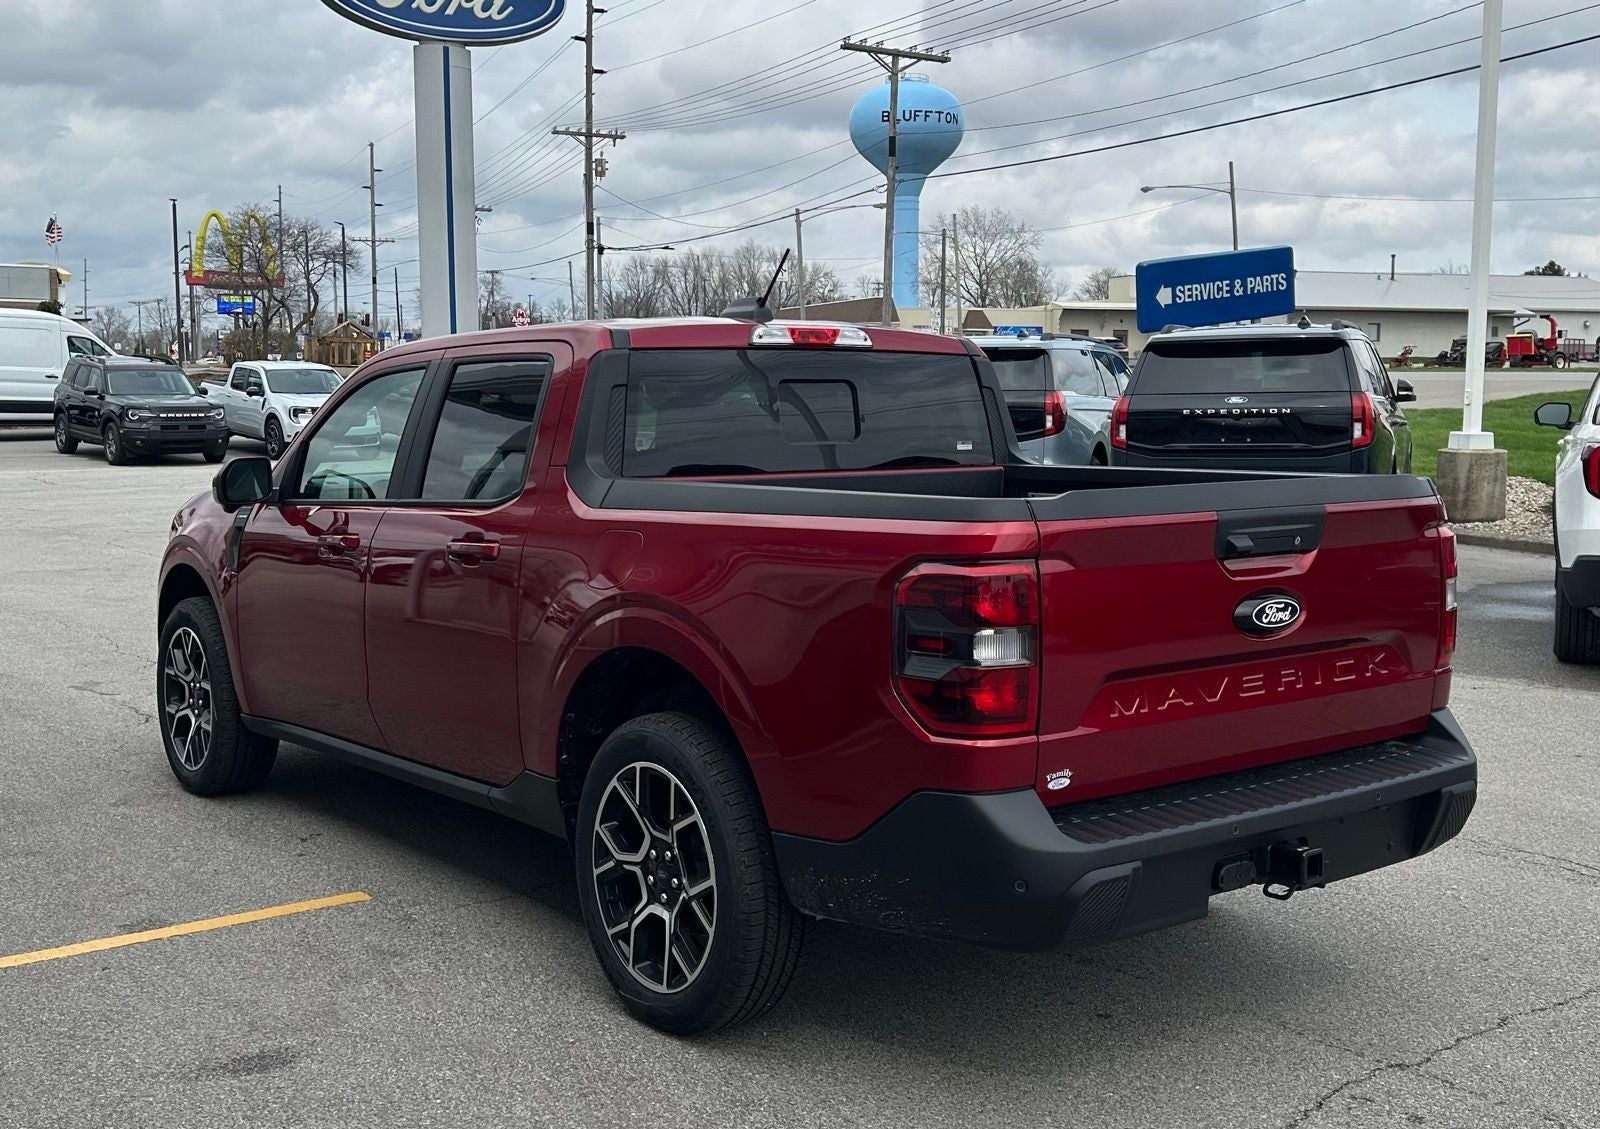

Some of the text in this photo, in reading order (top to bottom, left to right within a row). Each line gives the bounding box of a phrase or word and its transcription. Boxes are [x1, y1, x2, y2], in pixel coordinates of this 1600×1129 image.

[1175, 273, 1287, 304] SERVICE & PARTS
[1263, 602, 1291, 623] Ford
[1109, 651, 1390, 719] MAVERICK
[1046, 769, 1073, 781] Family
